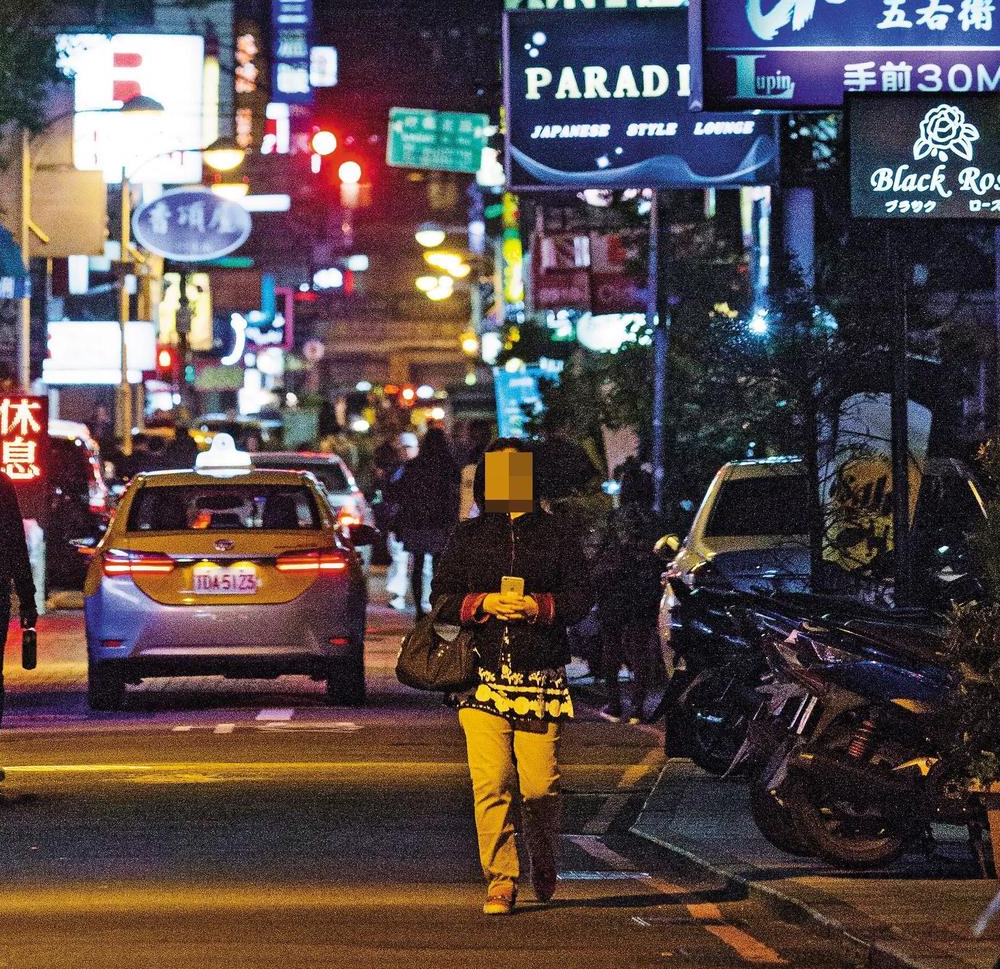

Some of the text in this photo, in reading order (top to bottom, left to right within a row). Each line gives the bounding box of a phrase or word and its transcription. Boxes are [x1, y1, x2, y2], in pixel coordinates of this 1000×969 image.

[707, 54, 795, 99] Lupin
[531, 121, 755, 139] JAPANESE STYLE LOUNGE
[870, 164, 953, 198] Black
